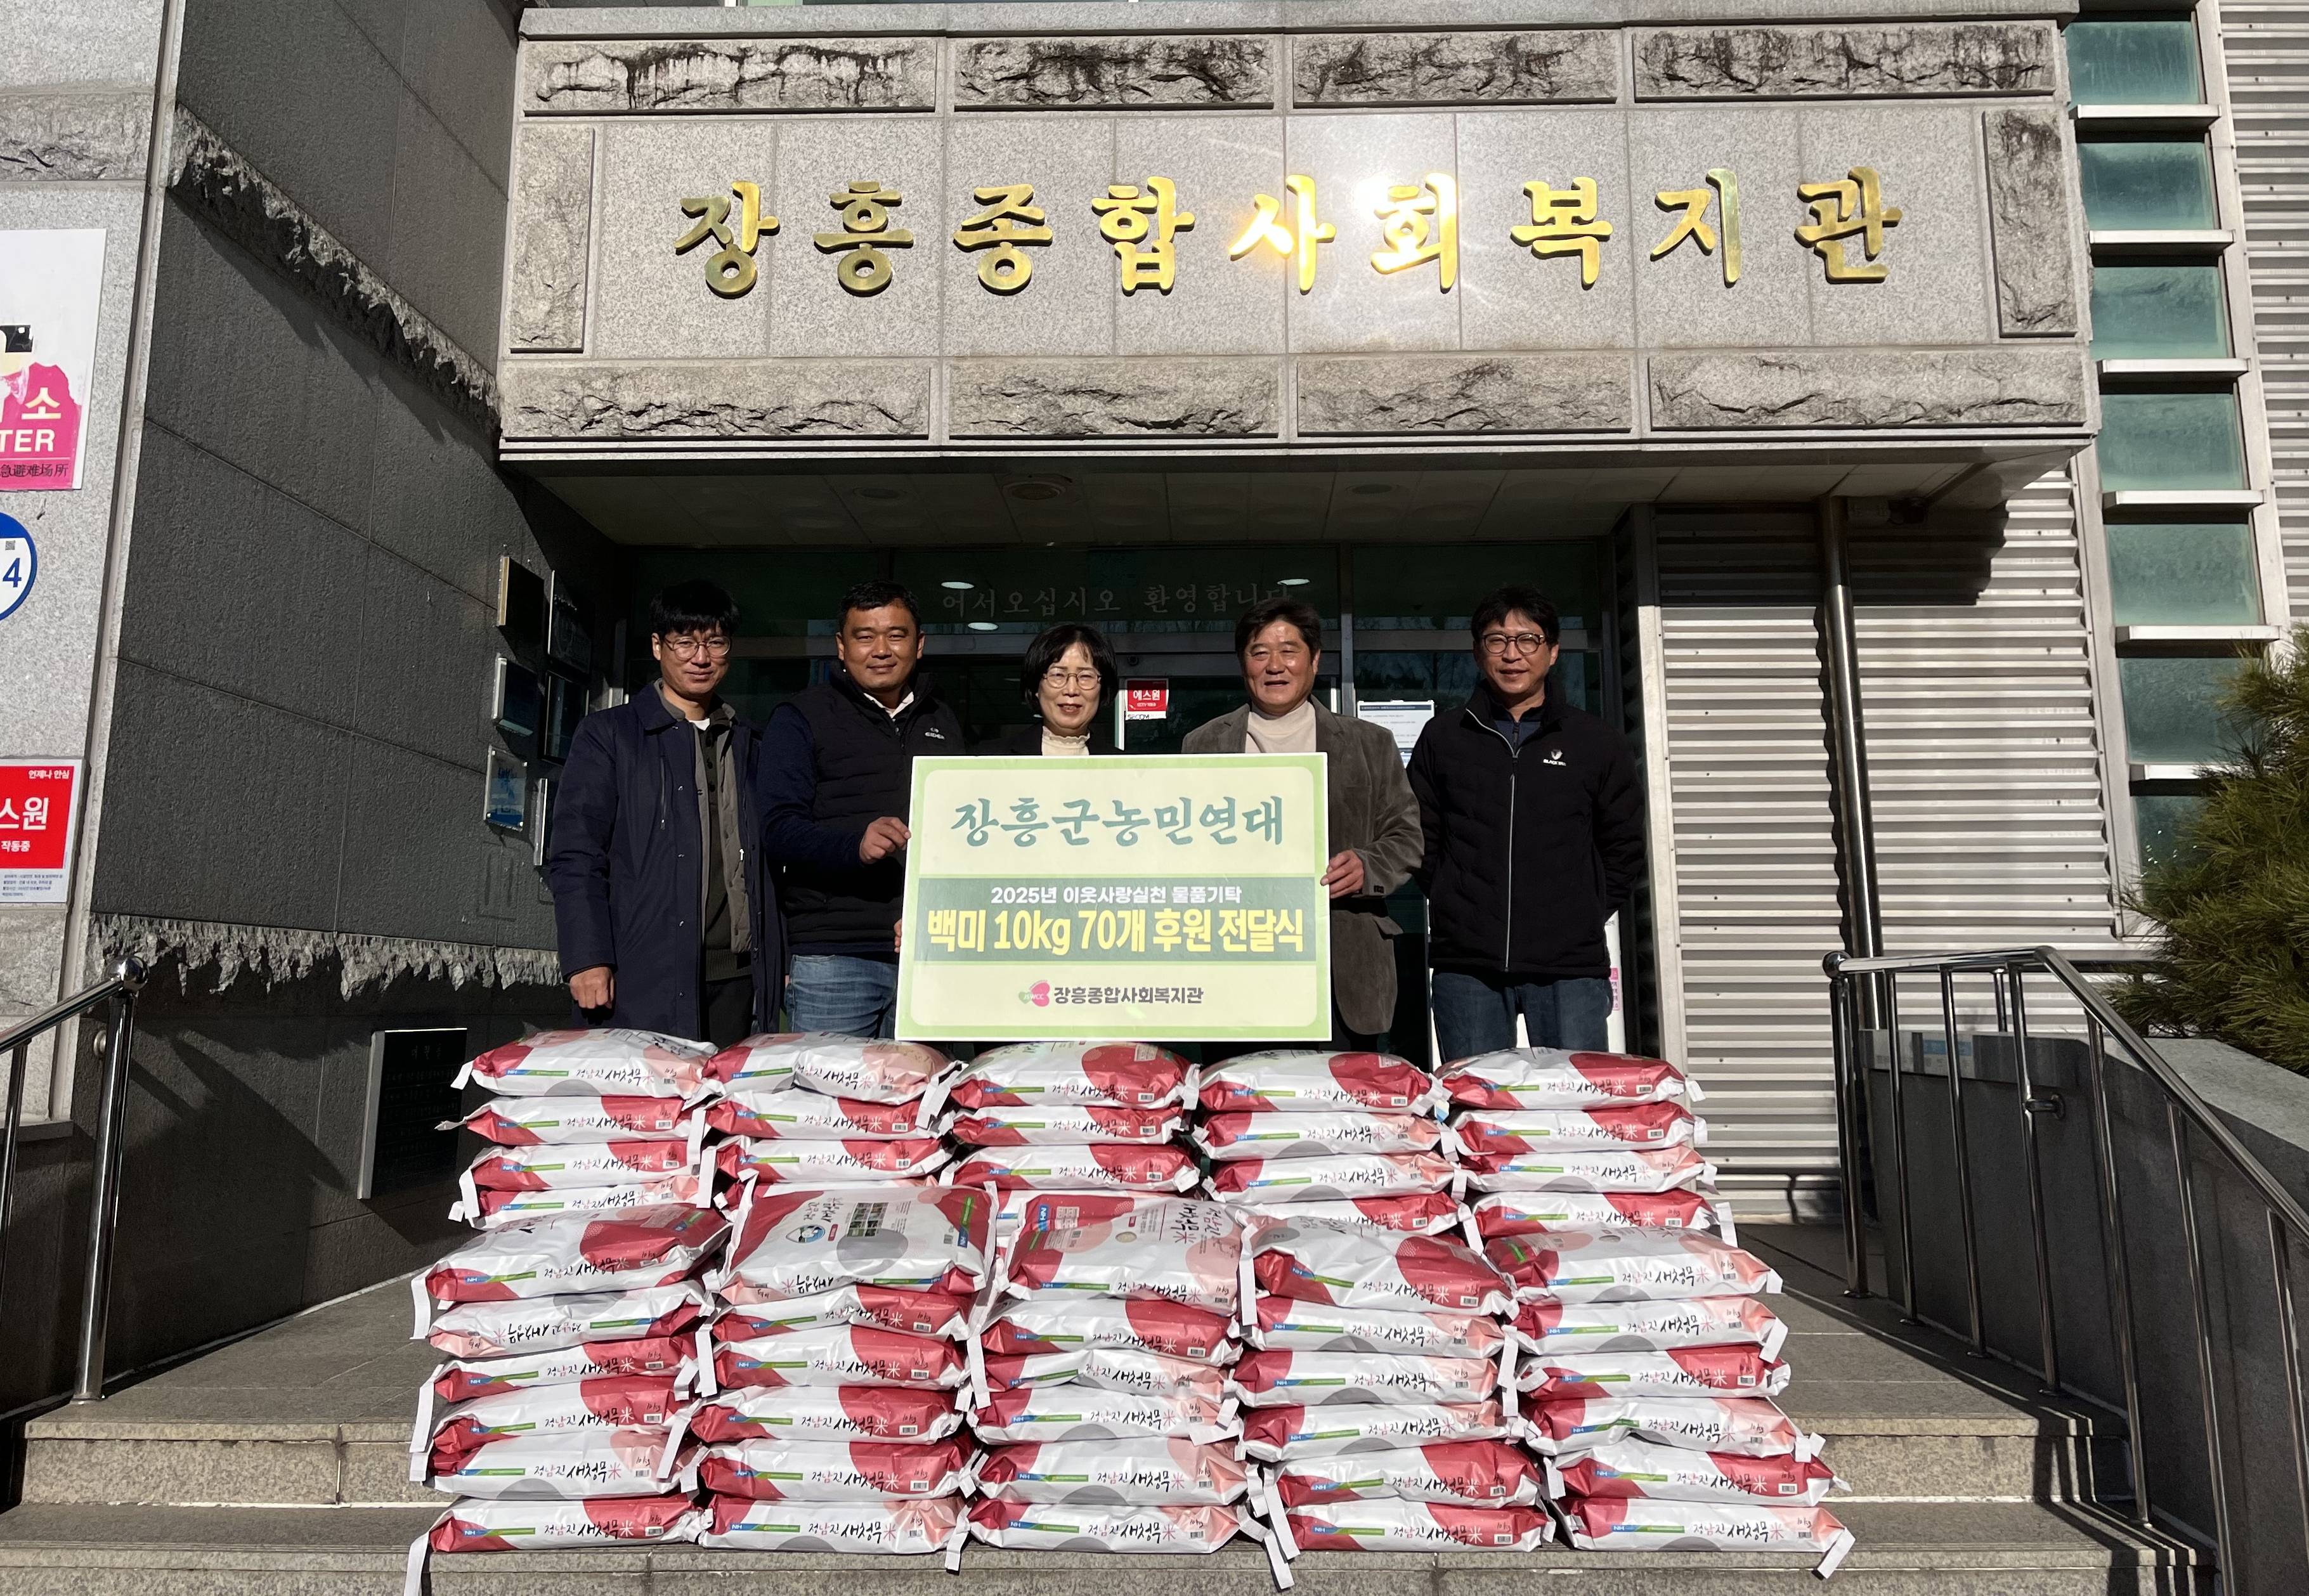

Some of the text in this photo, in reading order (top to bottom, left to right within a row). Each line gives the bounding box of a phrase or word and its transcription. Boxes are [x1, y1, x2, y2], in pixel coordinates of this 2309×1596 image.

[673, 166, 1901, 296] 장흥종합사회복지관
[0, 387, 61, 422] 소
[3, 558, 22, 587] 4
[942, 587, 1121, 618] 어서오십시오
[1133, 690, 1160, 700] 에스원
[0, 797, 49, 831] 스원
[951, 796, 1283, 847] 장흥군농민연대
[1, 841, 30, 852] 작동중
[991, 886, 1242, 904] 2025년 이웃사랑실천 물품기탁
[928, 908, 1304, 956] 백미 10kg 70개 후원 전달식
[1054, 987, 1204, 1005] 장흥종합사회복지관
[1547, 1082, 1575, 1091] 정남진
[1558, 1127, 1586, 1136] 정남진
[1571, 1165, 1599, 1174] 정남진
[1040, 1206, 1047, 1221] NH
[1577, 1211, 1604, 1221] 정남진
[544, 1266, 573, 1278] 정남진
[1623, 1271, 1653, 1283] 정남진
[1117, 1282, 1147, 1292] 정남진
[1363, 1281, 1393, 1292] 정남진
[552, 1323, 581, 1335] 정남진
[1352, 1325, 1382, 1336] 정남진
[1628, 1321, 1658, 1332] 정남진
[1093, 1334, 1122, 1344] 정남진
[815, 1359, 845, 1370] 정남진
[547, 1364, 577, 1377] 정남진
[1086, 1364, 1110, 1377] 정남진
[1354, 1374, 1385, 1385] 정남진
[1639, 1372, 1670, 1382] 정남진
[545, 1417, 575, 1427] 정남진
[802, 1416, 832, 1427] 정남진
[1090, 1411, 1121, 1422] 정남진
[1649, 1418, 1679, 1431] 정남진
[1369, 1425, 1399, 1436] 정남진
[534, 1465, 565, 1476] 정남진
[812, 1470, 842, 1482] 정남진
[1097, 1472, 1128, 1484] 정남진
[1393, 1477, 1423, 1488] 정남진
[1677, 1473, 1708, 1485] 정남진
[544, 1523, 575, 1534] 정남진
[809, 1524, 839, 1534] 정남진
[1088, 1524, 1119, 1535] 정남진
[1394, 1526, 1424, 1538] 정남진
[1693, 1523, 1724, 1535] 정남진
